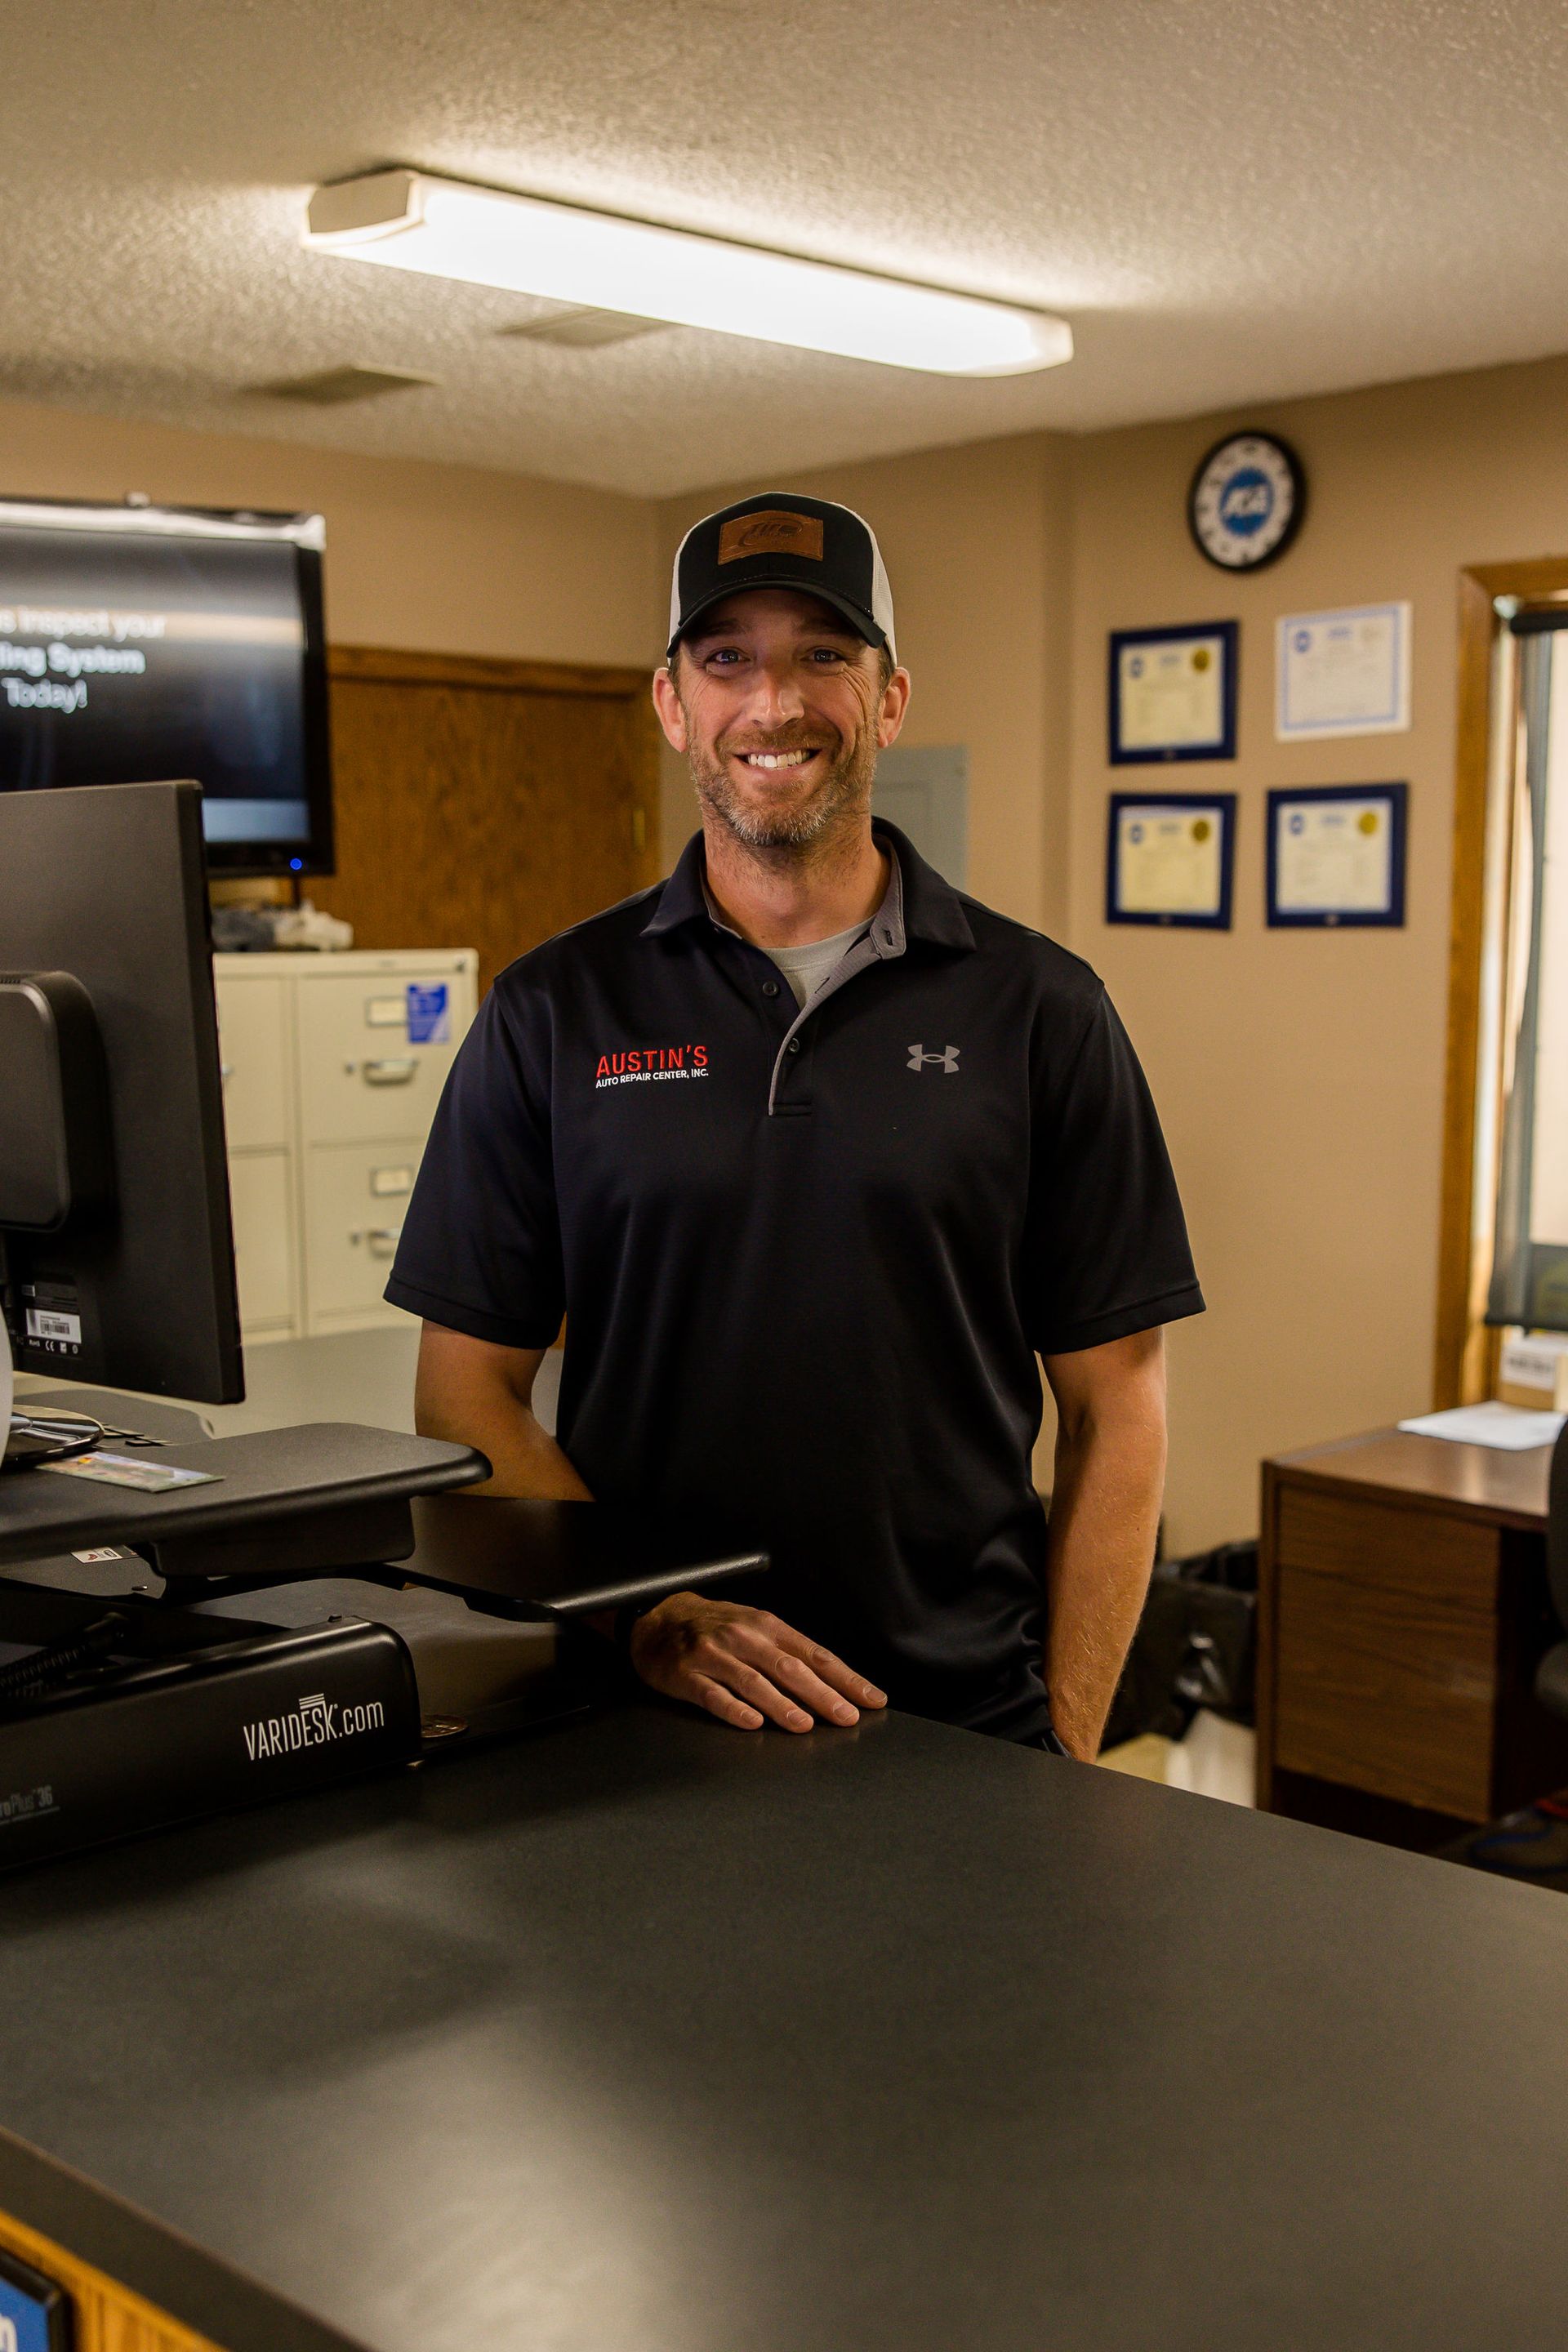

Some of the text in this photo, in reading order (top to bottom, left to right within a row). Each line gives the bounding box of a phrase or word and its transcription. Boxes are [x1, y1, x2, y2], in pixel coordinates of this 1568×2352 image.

[47, 643, 145, 678] System
[2, 677, 87, 713] Today!
[596, 1045, 708, 1078] AUSTIN'S
[595, 1068, 709, 1089] AUTO REPAIR CENTER, INC.
[38, 1785, 53, 1807] 36
